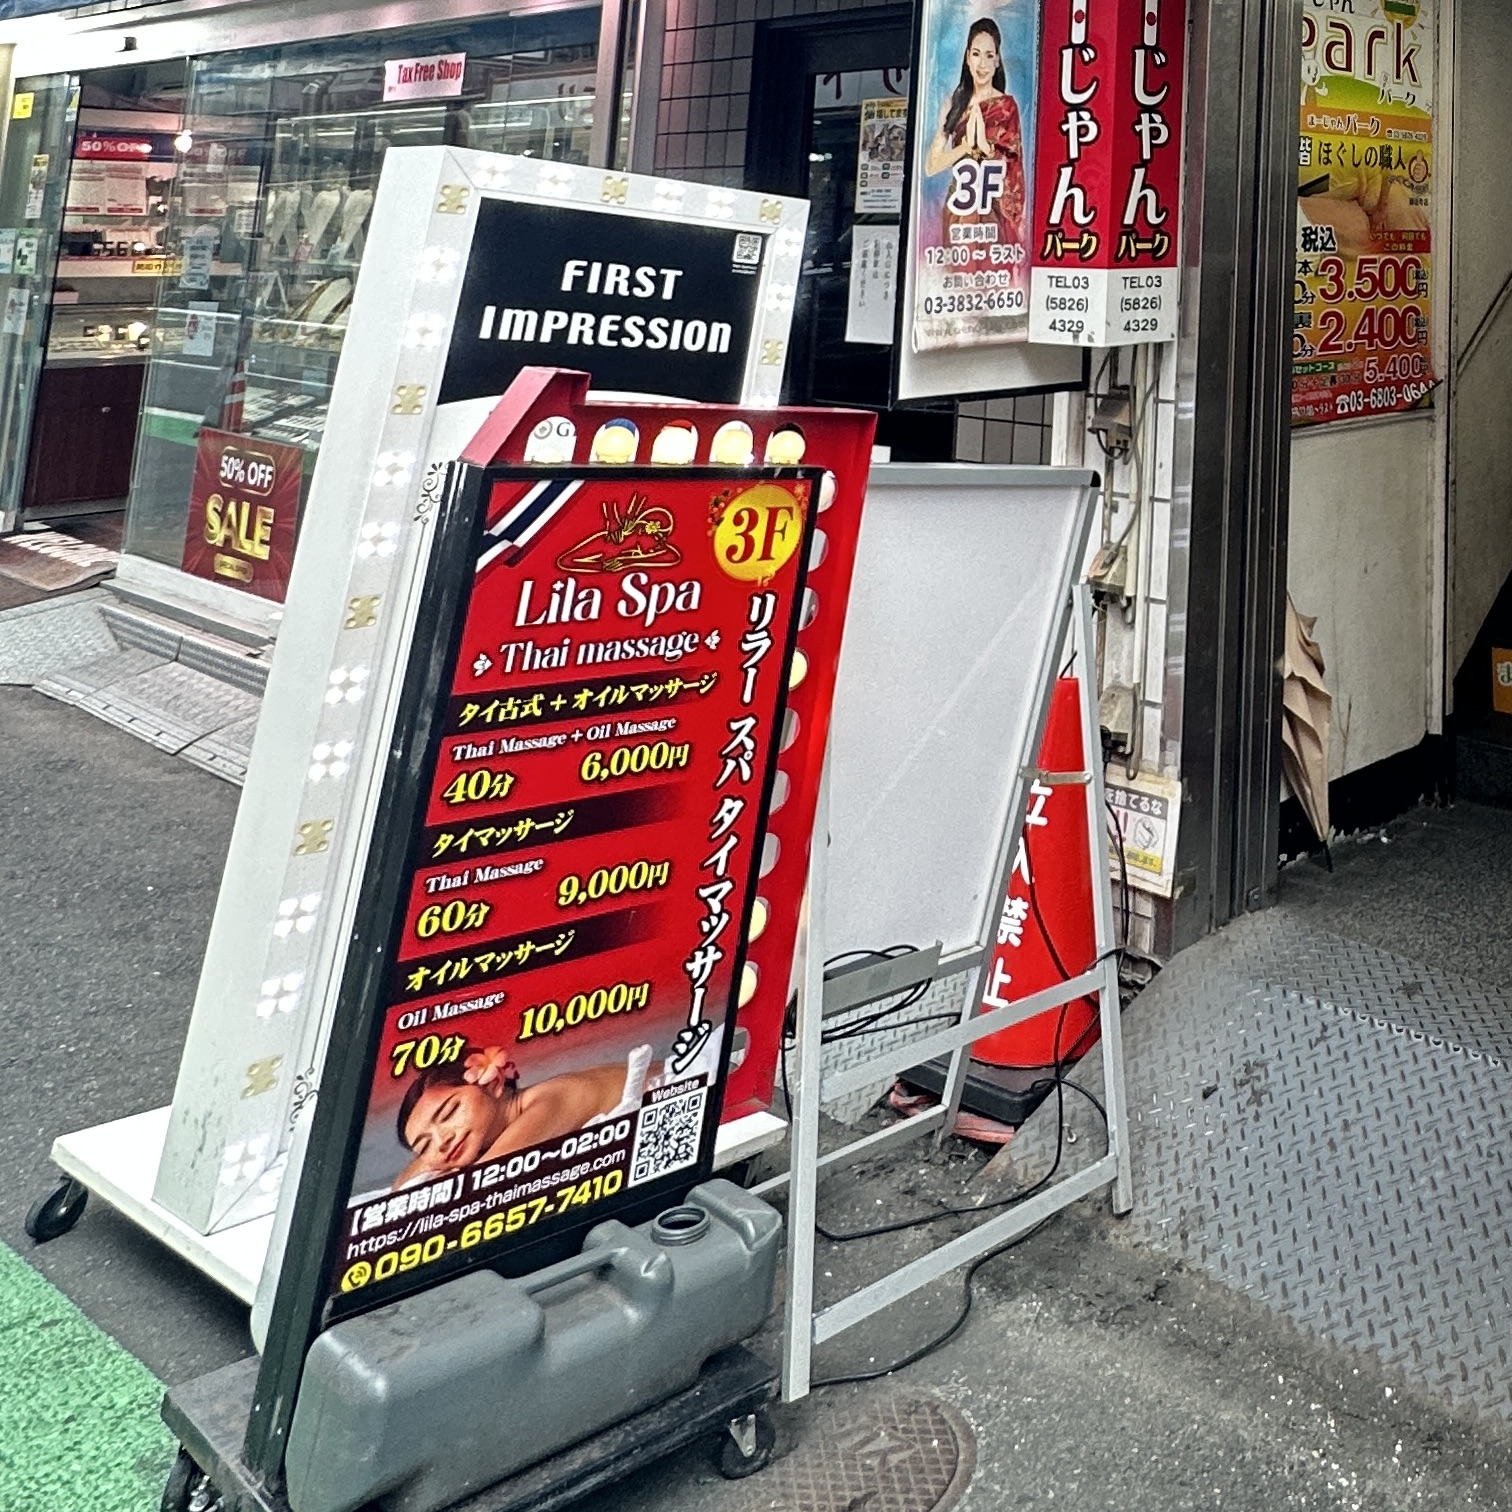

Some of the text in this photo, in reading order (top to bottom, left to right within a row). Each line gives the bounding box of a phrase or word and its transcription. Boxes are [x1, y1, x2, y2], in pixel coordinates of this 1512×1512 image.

[398, 57, 463, 86] Tax Free Shop
[1377, 86, 1417, 108] パーク
[1318, 141, 1407, 171] ほぐしの職人
[947, 160, 1007, 217] 3F
[951, 226, 997, 241] 営業時間
[1042, 231, 1099, 261] パーク
[1115, 231, 1172, 261] パーク
[927, 248, 969, 265] 12:00
[991, 246, 1025, 263] ラスト
[560, 259, 683, 301] FIRST
[1047, 273, 1090, 291] TEL03
[1121, 273, 1163, 291] TEL03
[924, 291, 1024, 315] 03-3832-6650
[1045, 294, 1090, 314] (5826)
[1119, 294, 1163, 313] (5826)
[478, 305, 732, 355] IMPRESSION
[1048, 316, 1085, 334] 4329
[1122, 316, 1160, 334] 4329
[219, 455, 275, 489] 50% OFF
[203, 493, 276, 561] SALE
[725, 505, 794, 565] 3F
[514, 572, 702, 628] Lila Spa
[499, 630, 700, 675] Thai massage
[459, 692, 544, 728] タイ古式
[571, 671, 719, 713] オイルマッサージ
[452, 741, 495, 762] Thai
[498, 731, 567, 754] Massage
[586, 723, 612, 741] Oil
[615, 716, 677, 739] Massage
[442, 742, 691, 806] 40分 6,000円
[431, 809, 576, 859] タイマッサージ
[672, 593, 776, 1075] リラー スパ タイマッサージ
[426, 857, 544, 895] Thai Massage
[416, 861, 670, 939] 60分 9,000円
[405, 929, 576, 992] オイルマッサージ
[391, 981, 651, 1077] 70分 10,000円
[397, 990, 506, 1032] Oil Massage
[651, 1077, 701, 1103] Website
[346, 1146, 627, 1261] https://lila-spa-thaimassage.com
[347, 1175, 464, 1237] 【営業時間】
[373, 1169, 623, 1281] 090-6657-7410
